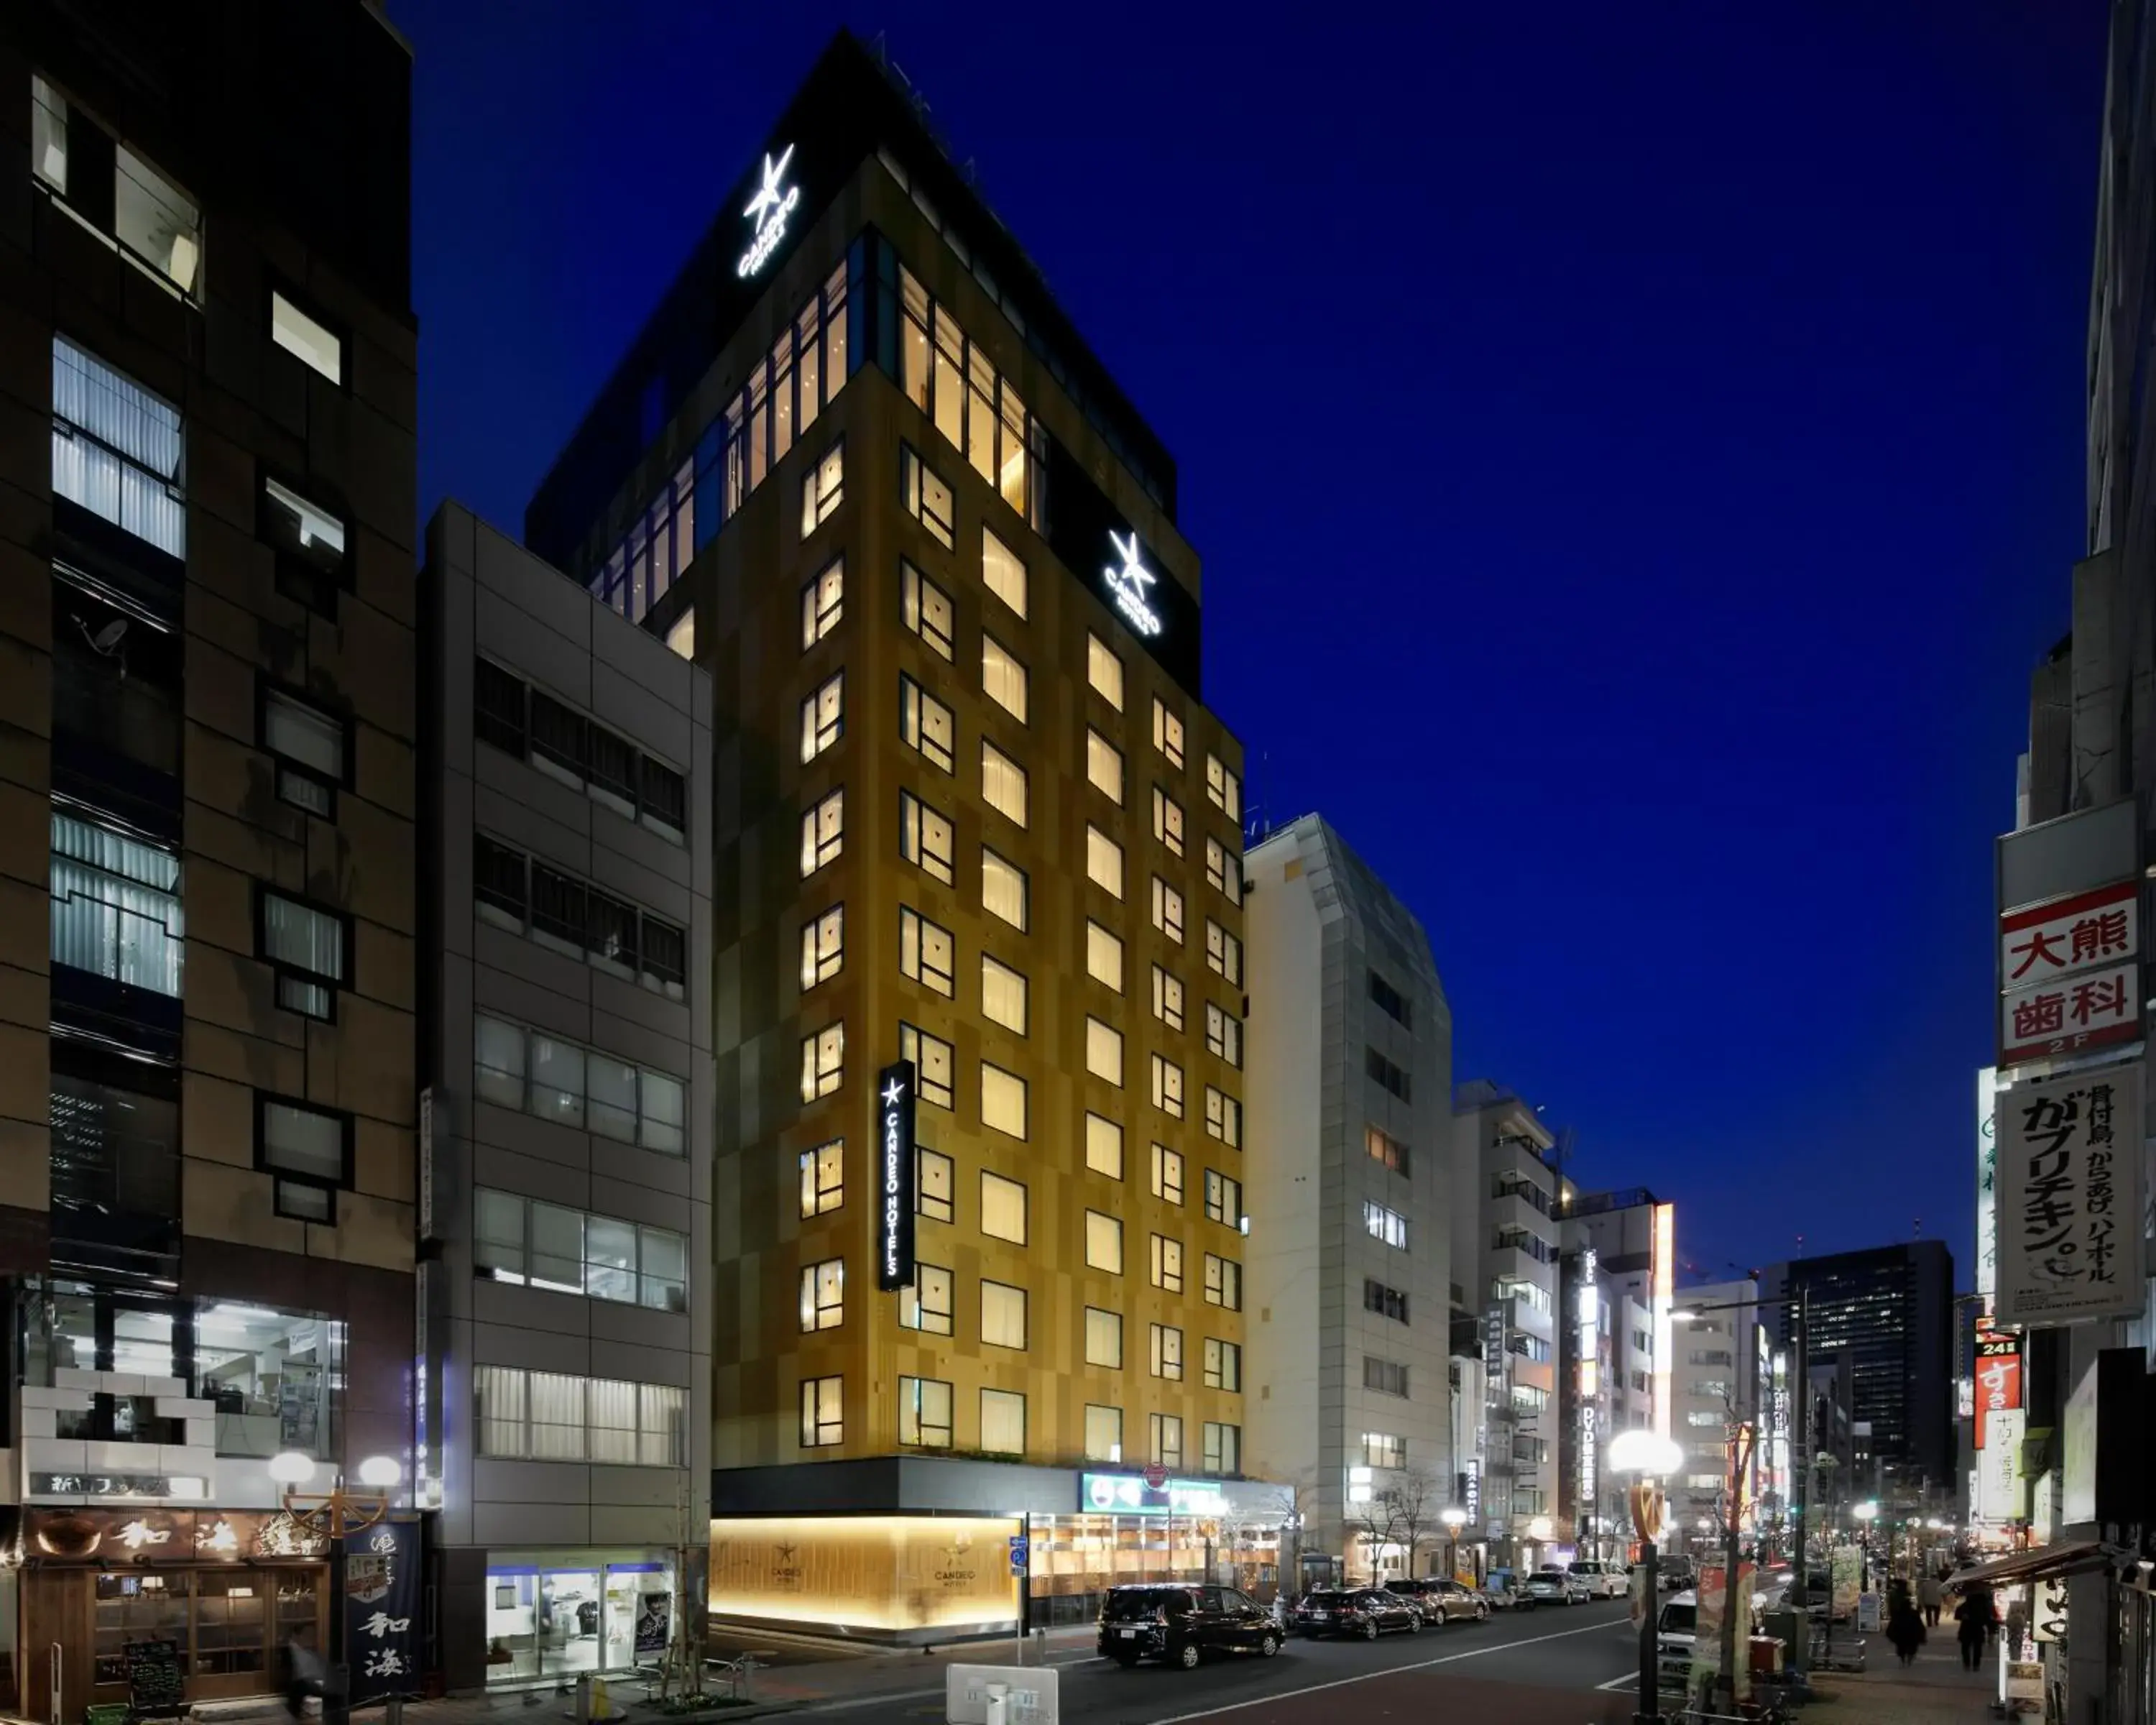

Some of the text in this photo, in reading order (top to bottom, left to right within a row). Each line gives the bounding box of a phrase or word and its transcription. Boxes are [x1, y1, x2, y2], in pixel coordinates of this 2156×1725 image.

[2011, 909, 2128, 979] 大熊
[2013, 974, 2128, 1039] 歯科
[886, 1113, 898, 1276] CANDEO HOTELS
[935, 1570, 976, 1581] CANDEO
[357, 1611, 411, 1678] 和海
